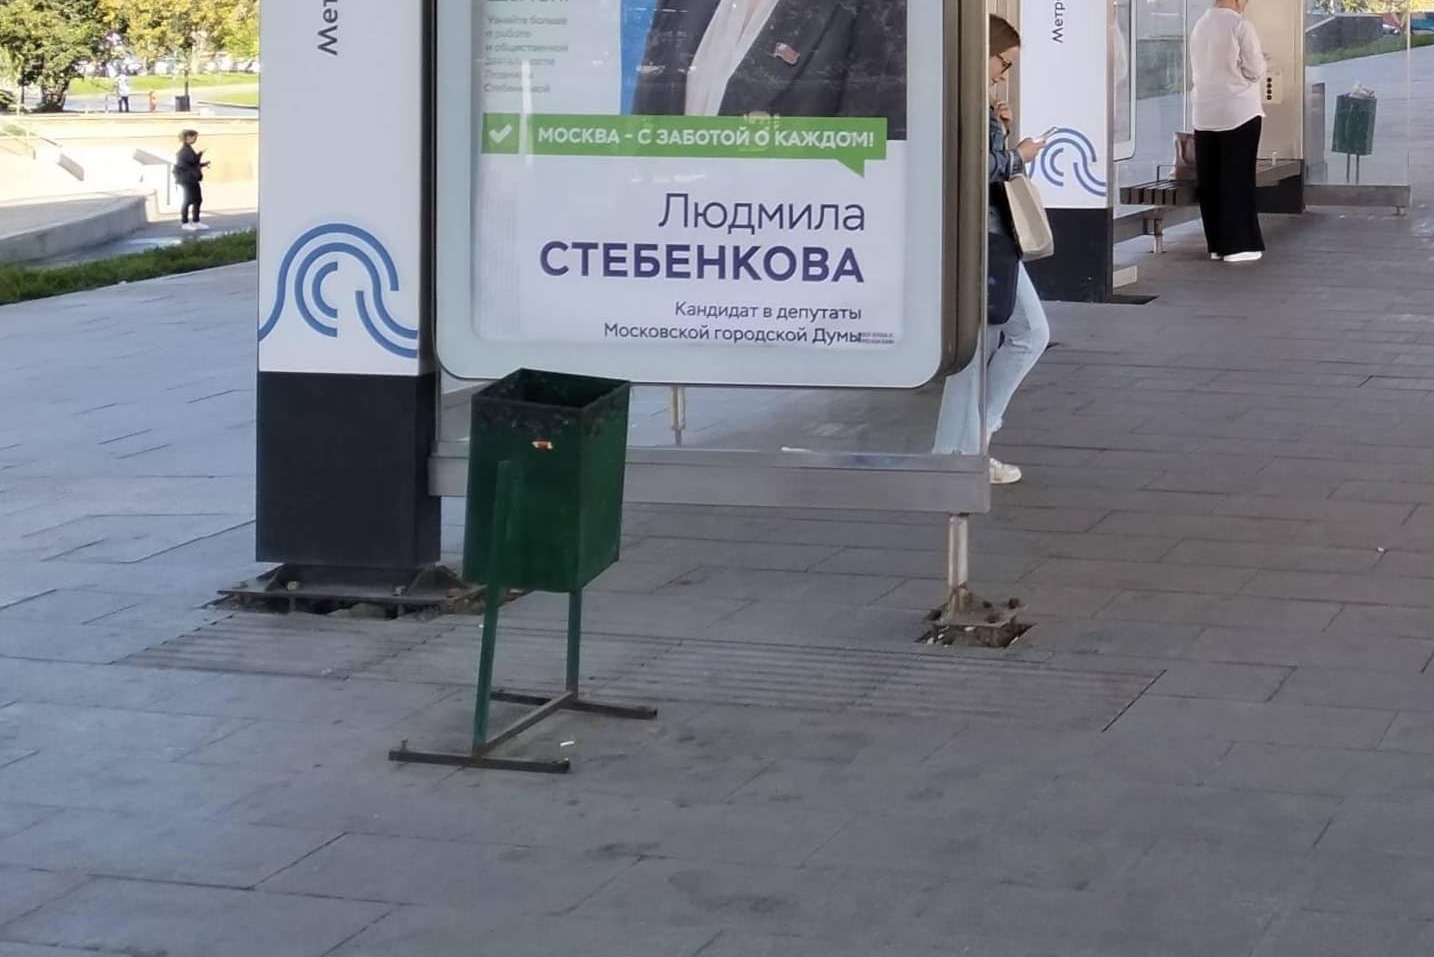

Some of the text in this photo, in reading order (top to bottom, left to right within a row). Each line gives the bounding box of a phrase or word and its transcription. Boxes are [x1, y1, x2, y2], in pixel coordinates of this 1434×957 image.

[537, 127, 620, 144] МОСКВА
[656, 126, 750, 146] ЗАБОТОЙ
[774, 130, 874, 149] КАЖДОМ!
[658, 193, 865, 235] Людмила
[540, 241, 864, 283] СТЕБЕНКОВА
[675, 301, 862, 323] Кандидат в депутаты
[604, 322, 862, 345] Московской городской Думы
